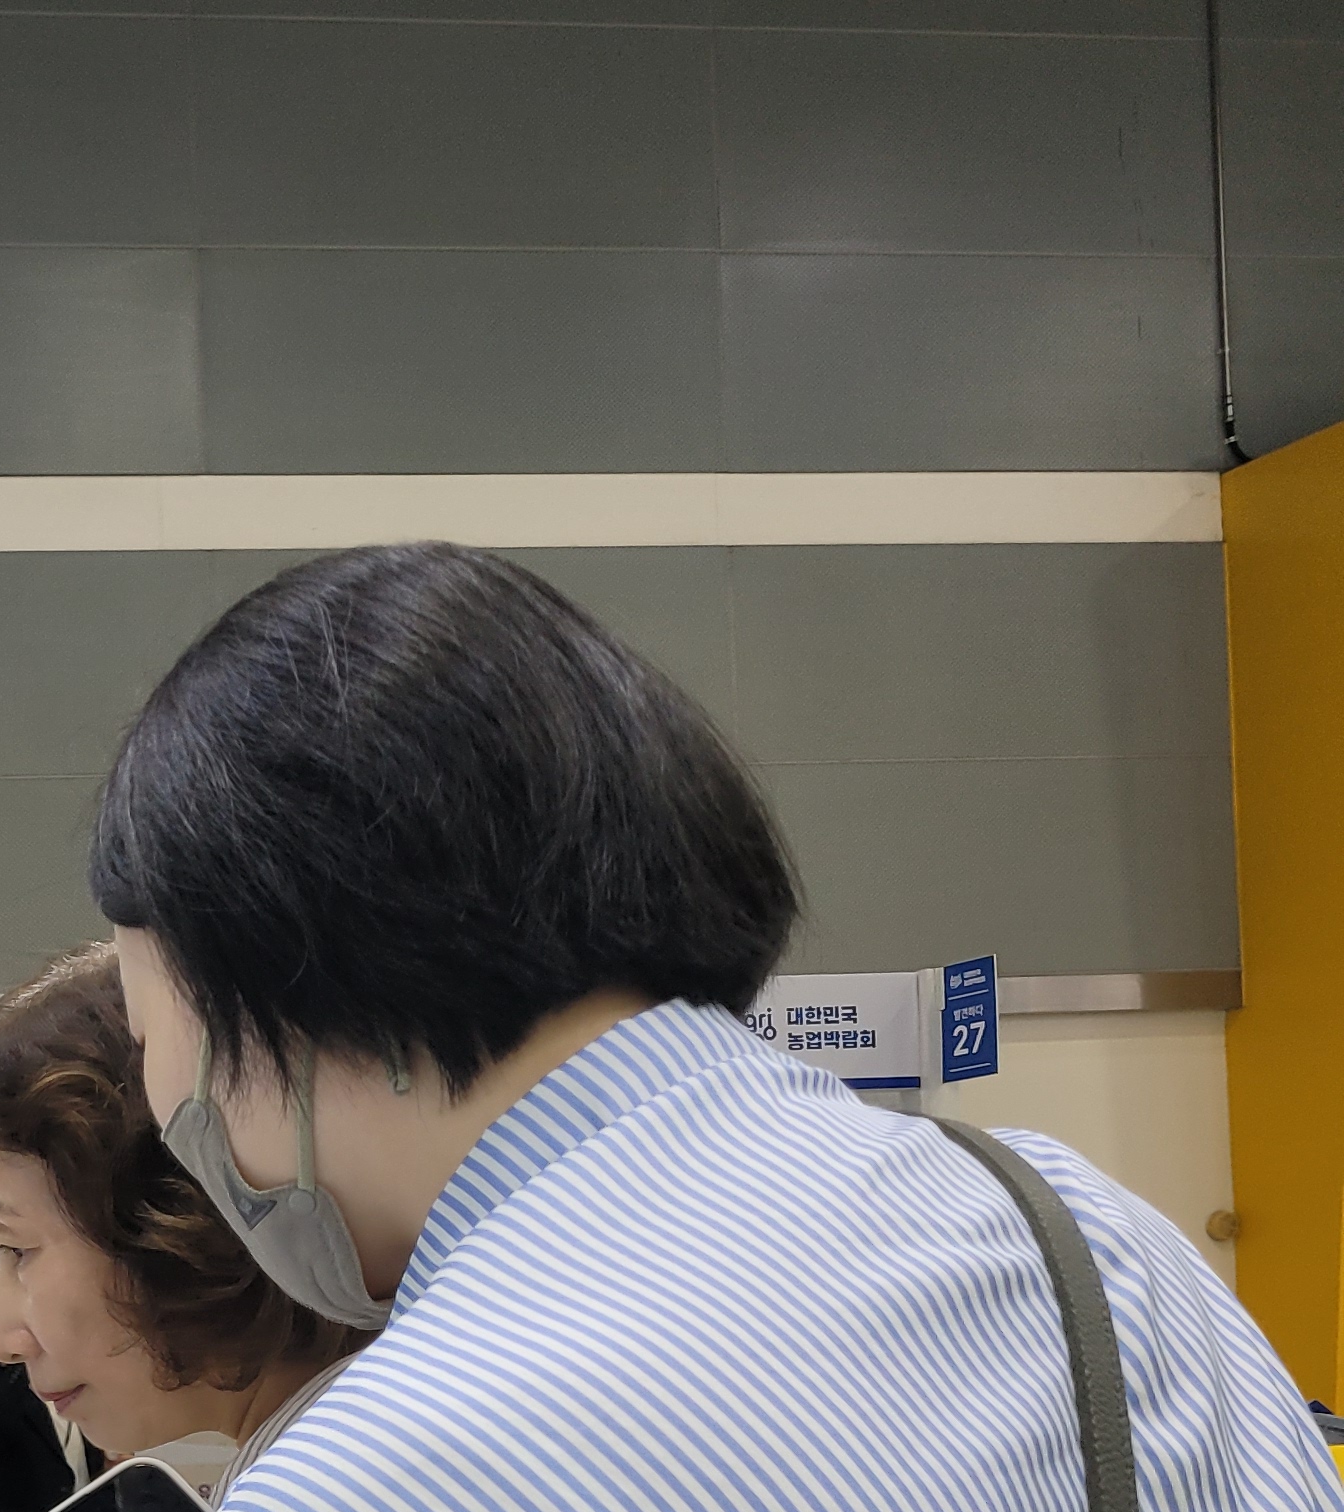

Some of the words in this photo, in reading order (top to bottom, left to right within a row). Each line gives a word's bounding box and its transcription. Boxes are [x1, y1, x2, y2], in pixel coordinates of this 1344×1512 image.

[786, 1005, 858, 1026] 대한민국
[787, 1029, 877, 1051] 농업박람회
[953, 1021, 986, 1057] 27
